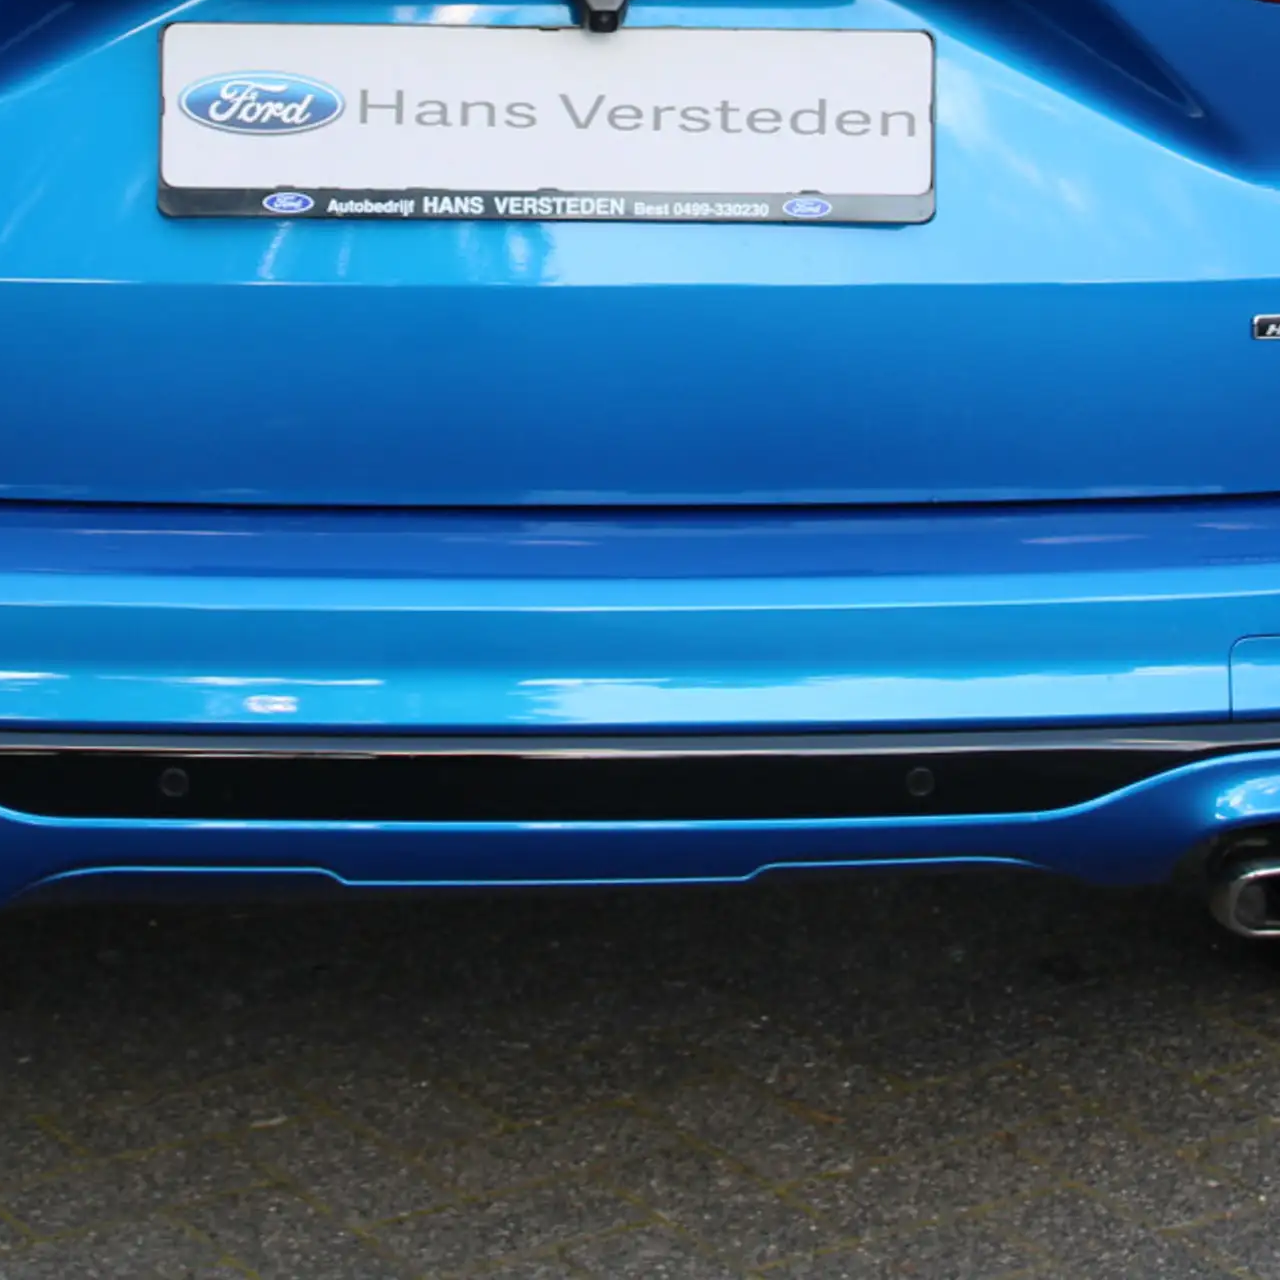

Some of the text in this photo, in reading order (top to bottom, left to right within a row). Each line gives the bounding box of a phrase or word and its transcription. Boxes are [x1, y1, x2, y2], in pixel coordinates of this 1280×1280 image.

[208, 80, 916, 138] Ford Hans Versteden
[326, 199, 415, 217] Autobedrijf
[423, 196, 484, 215] HANS
[494, 196, 626, 217] VERSTEDEN
[634, 202, 669, 215] Best
[673, 202, 769, 218] 0499-330230
